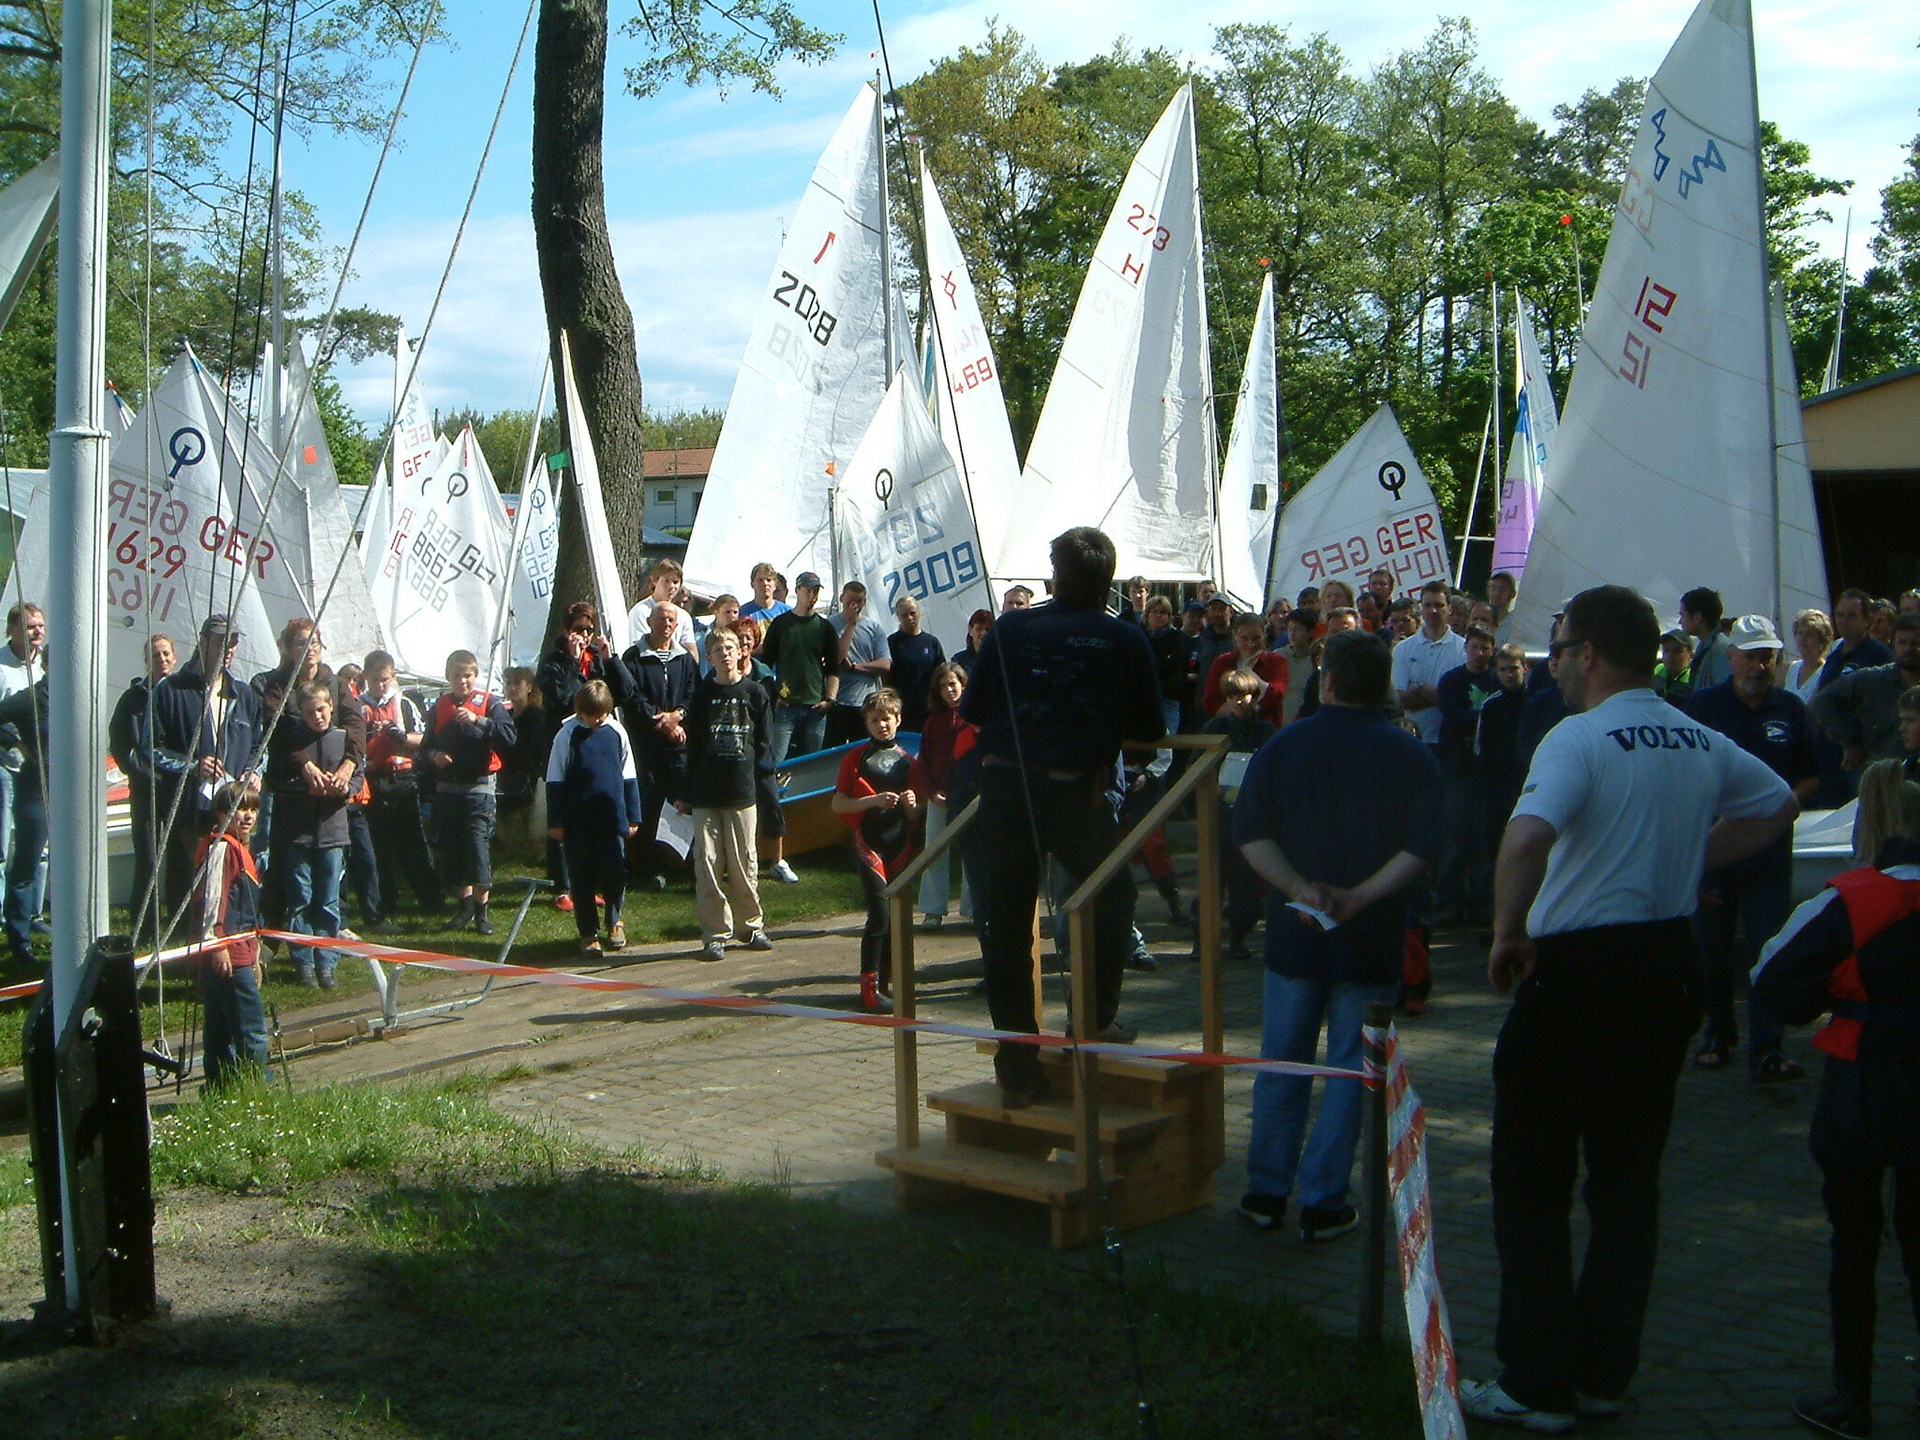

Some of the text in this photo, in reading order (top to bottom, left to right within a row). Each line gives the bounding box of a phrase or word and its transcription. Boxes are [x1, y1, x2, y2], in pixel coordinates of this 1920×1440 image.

[1126, 203, 1171, 252] 273
[1121, 252, 1144, 285] H
[773, 270, 838, 347] 2028
[199, 515, 275, 580] GER
[1375, 512, 1438, 556] GER
[1606, 725, 1711, 752] VOLVO
